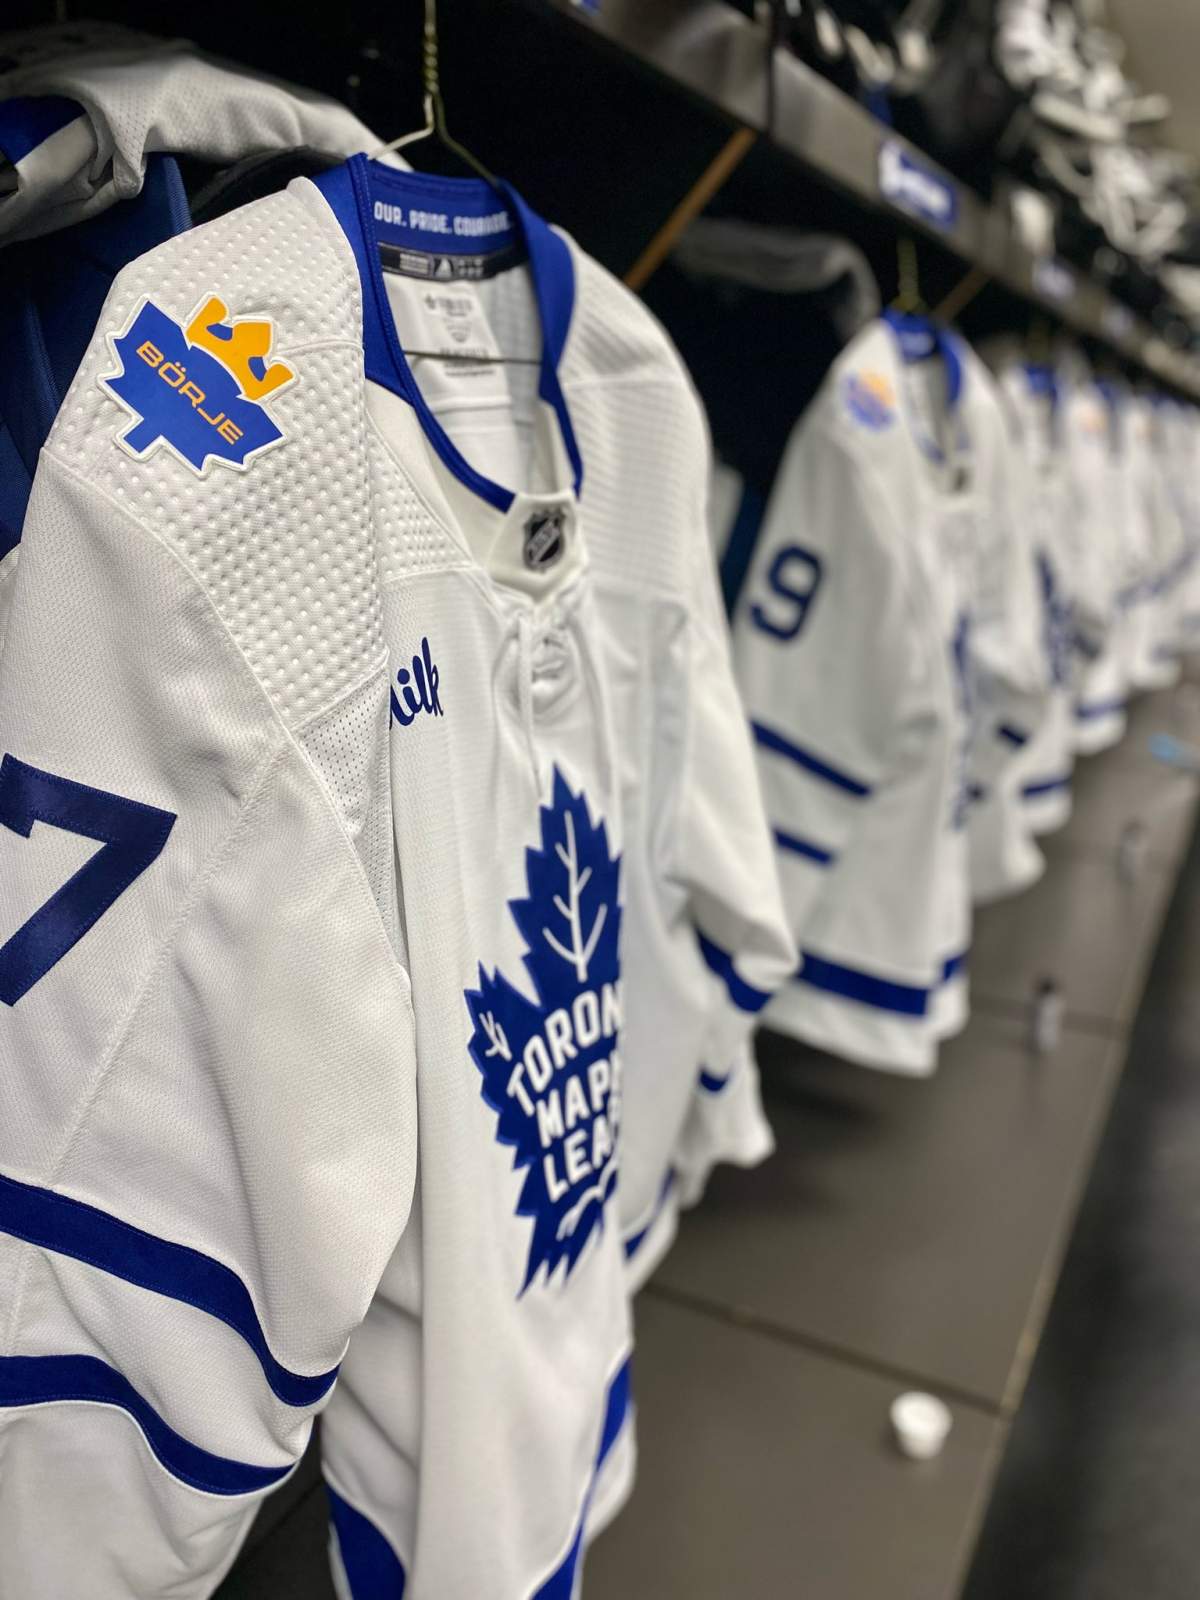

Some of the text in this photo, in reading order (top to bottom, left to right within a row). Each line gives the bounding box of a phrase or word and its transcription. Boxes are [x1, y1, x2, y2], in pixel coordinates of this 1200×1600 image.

[374, 201, 407, 226] OUR.
[409, 210, 453, 234] PRIDE.
[136, 341, 243, 445] BÖRJE
[749, 545, 823, 642] 9
[0, 752, 178, 1007] 7
[506, 980, 624, 1117] TORON
[536, 1054, 621, 1148] MAP
[543, 1104, 619, 1202] LEA
